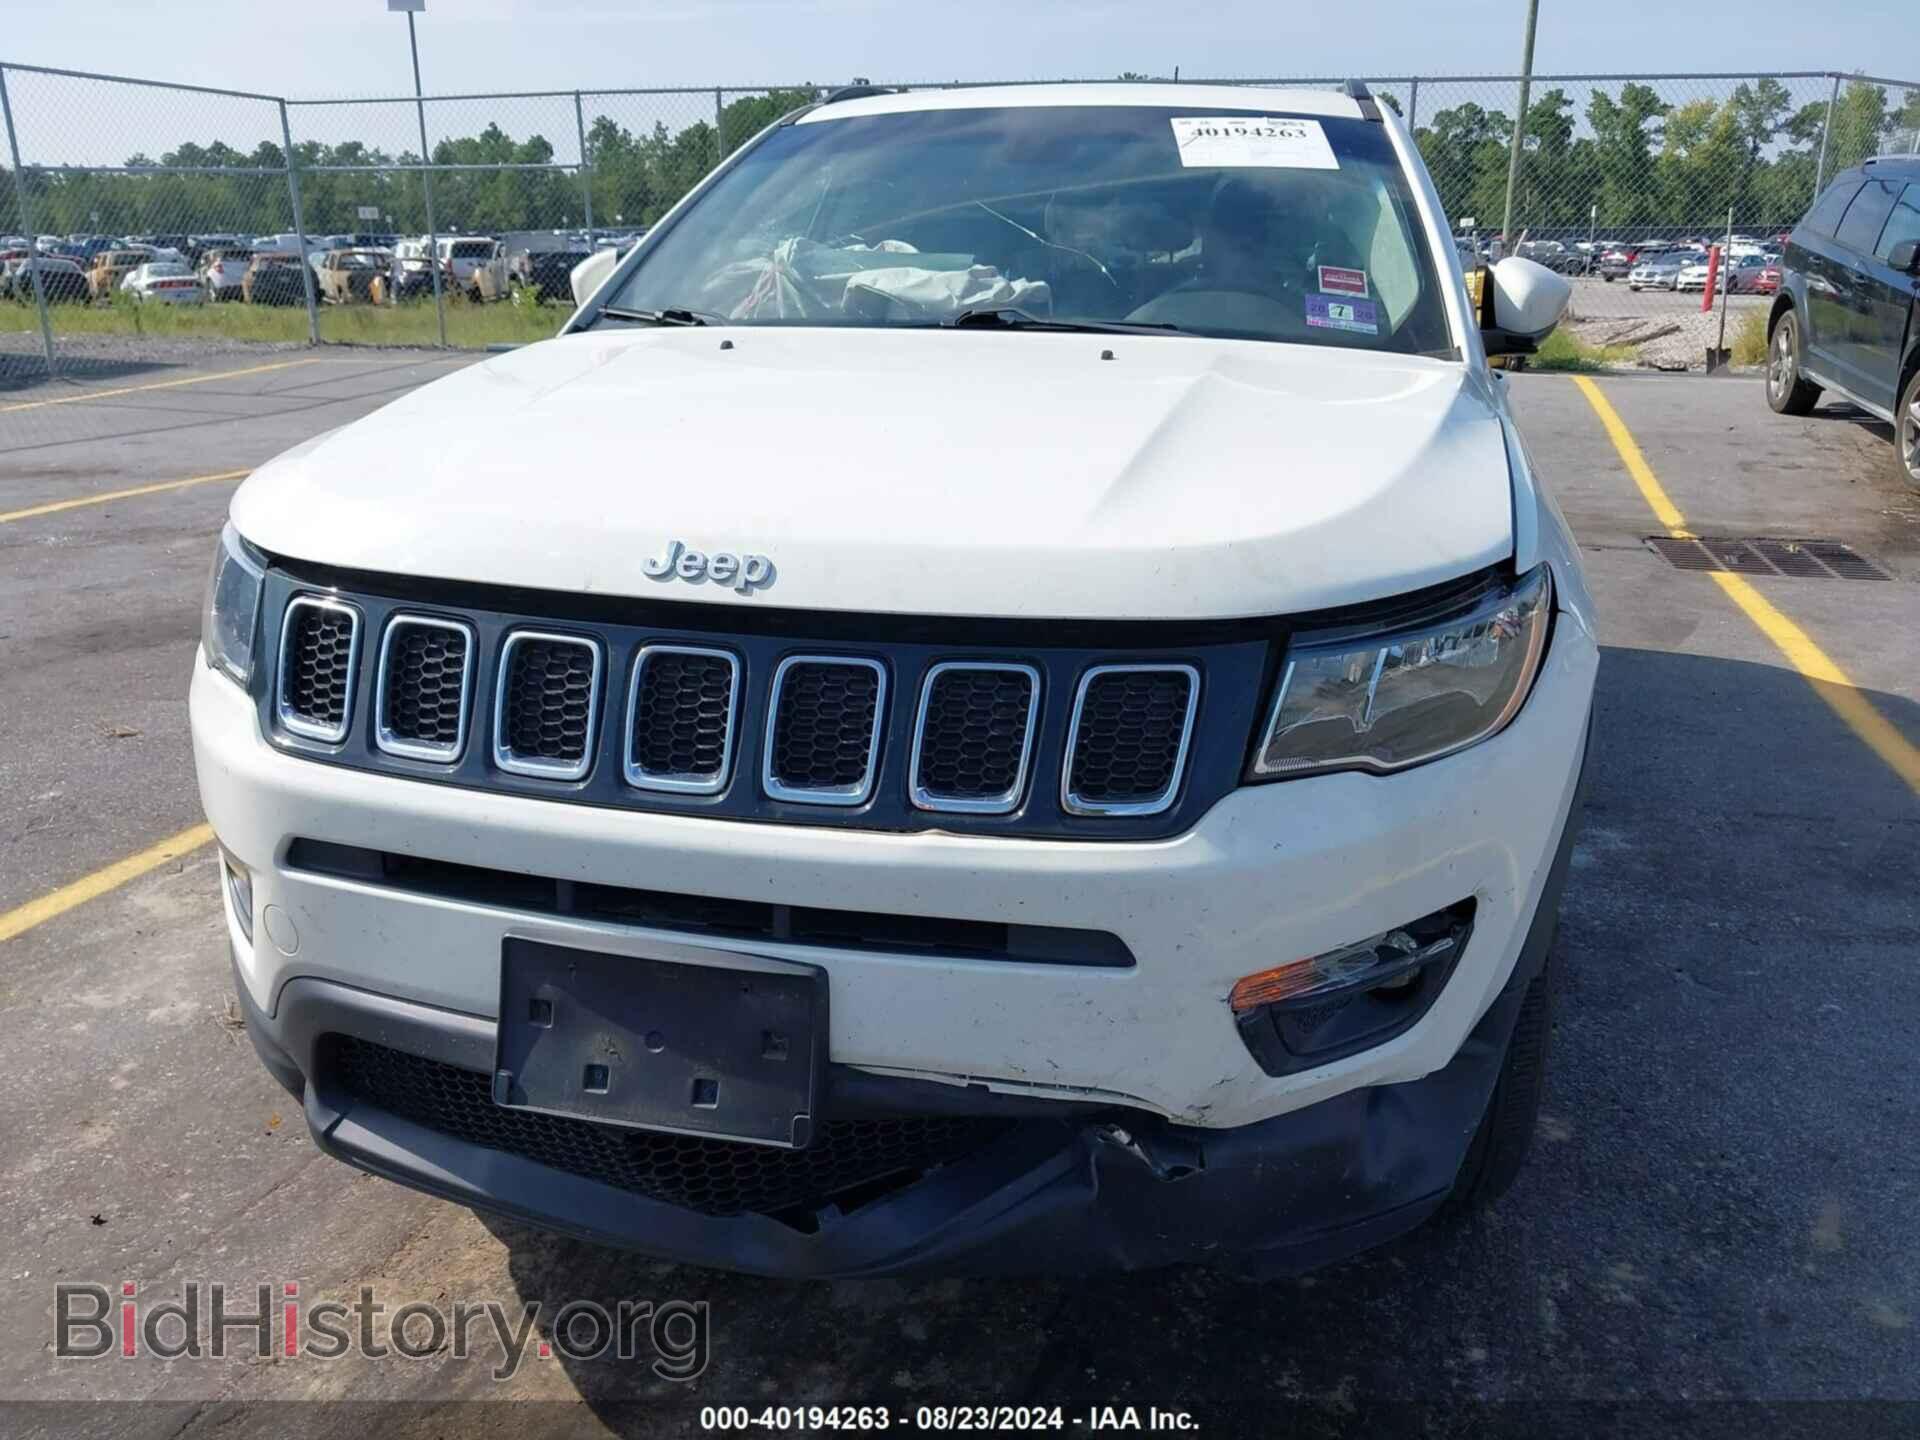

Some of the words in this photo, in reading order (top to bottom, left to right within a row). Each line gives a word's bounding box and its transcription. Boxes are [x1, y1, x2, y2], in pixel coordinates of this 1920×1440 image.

[1191, 127, 1307, 138] 40194263
[1336, 305, 1345, 317] 7
[641, 540, 777, 596] Jeep
